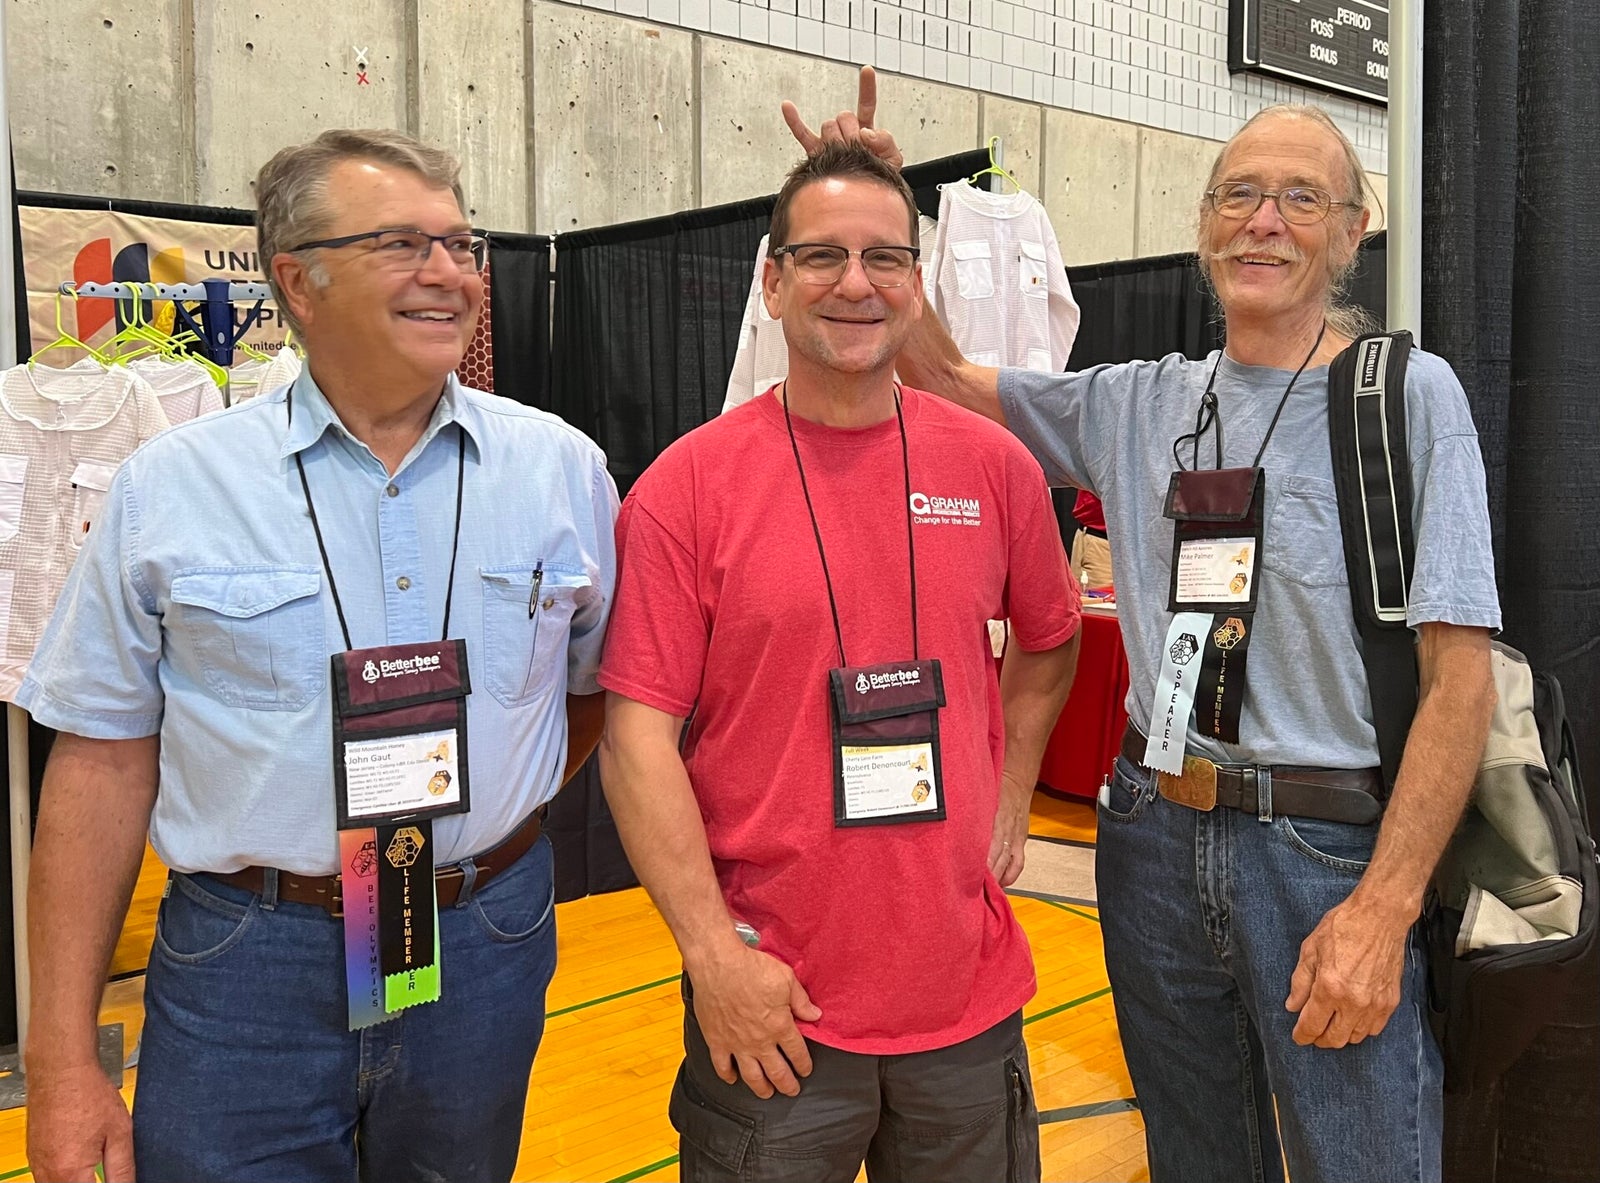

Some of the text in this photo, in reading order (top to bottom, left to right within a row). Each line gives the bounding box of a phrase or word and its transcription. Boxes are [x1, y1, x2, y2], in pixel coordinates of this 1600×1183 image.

[1310, 18, 1334, 38] POSS
[1337, 7, 1371, 31] PERIOD
[1310, 43, 1338, 66] BONUS
[1372, 38, 1389, 56] POS
[1366, 60, 1389, 80] BONU
[204, 250, 259, 272] UNI
[1364, 343, 1379, 384] TIMBUK2
[930, 496, 980, 511] GRAHAM
[914, 516, 981, 526] Change for the Better
[380, 655, 440, 672] Betterbee
[869, 670, 919, 685] Betterbee
[1214, 650, 1228, 735] LIFE MEMBER
[1162, 669, 1183, 751] SPEAKER
[348, 756, 368, 765] John
[370, 754, 391, 762] Gaut
[846, 760, 911, 772] Robert Denoncourt
[367, 884, 379, 1008] BEE OLYMPICS
[403, 908, 412, 964] MEMBER
[408, 971, 416, 991] ER
